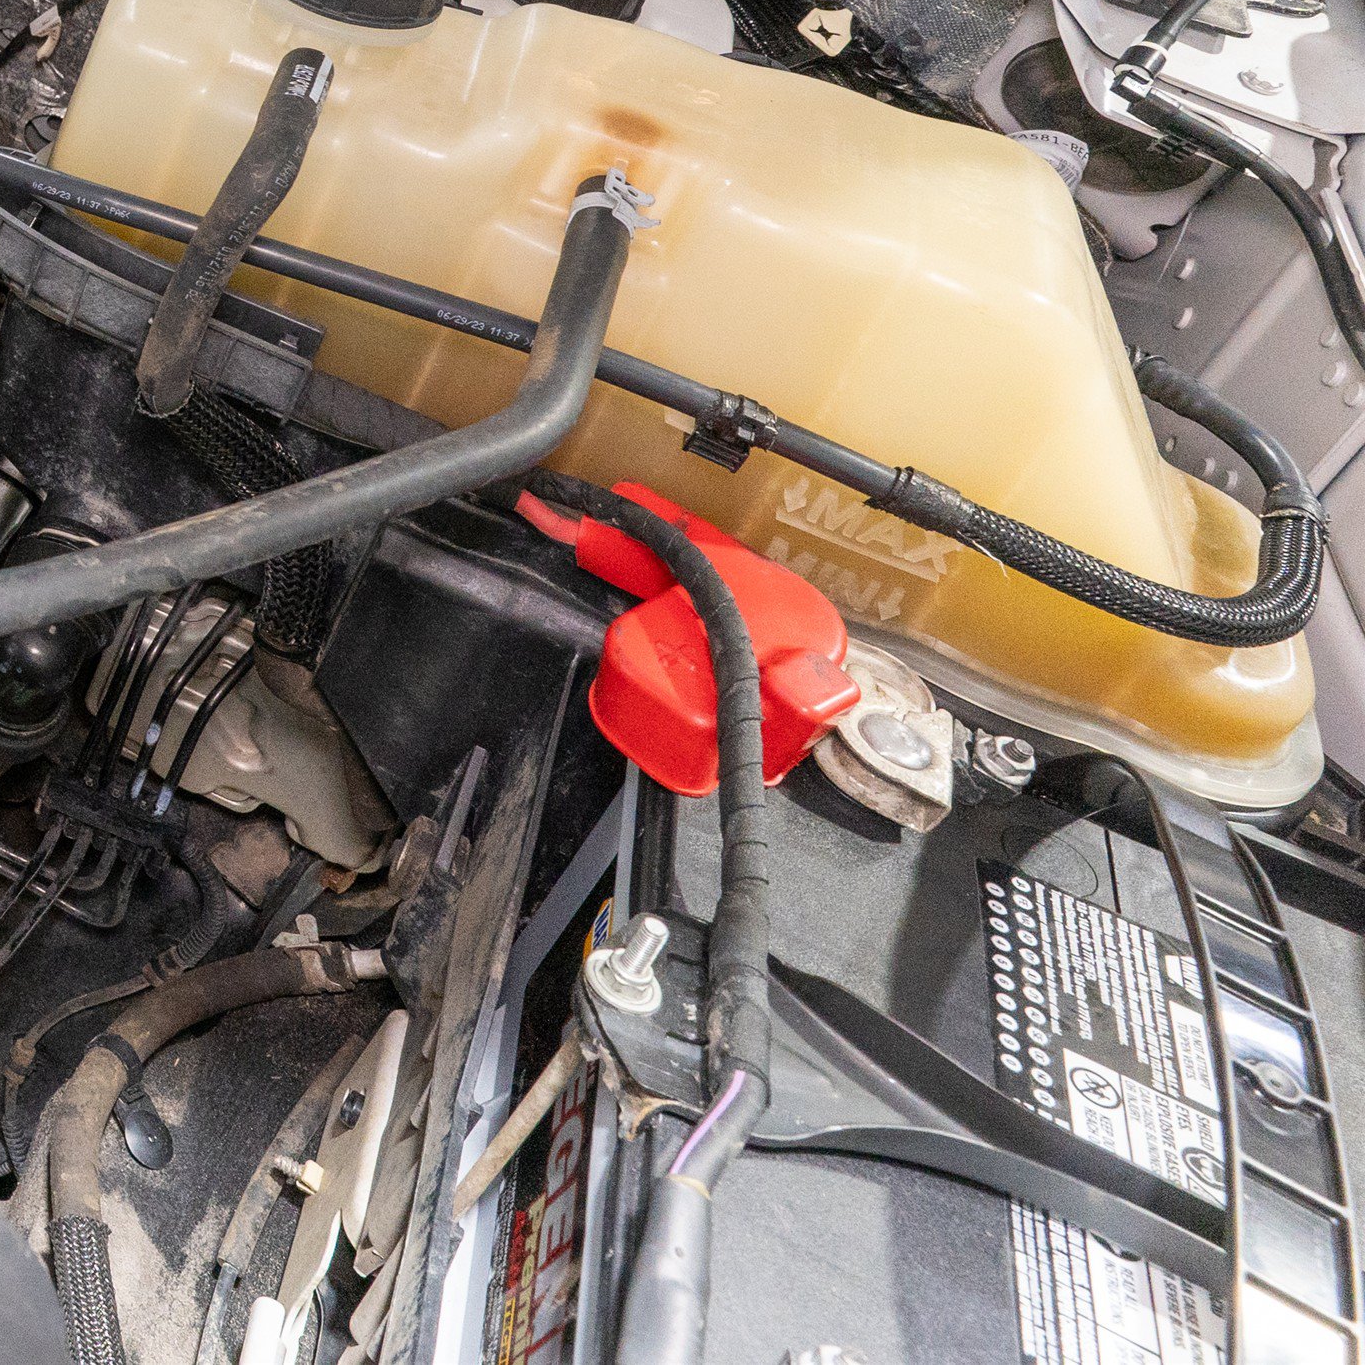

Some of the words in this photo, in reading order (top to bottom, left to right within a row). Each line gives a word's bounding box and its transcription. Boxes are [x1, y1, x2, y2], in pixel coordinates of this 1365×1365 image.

[30, 179, 72, 202] 06/29/23
[74, 194, 101, 211] 11:37
[437, 309, 485, 332] 06/29/23
[490, 326, 521, 342] 11:37
[806, 488, 963, 575] MAX
[1178, 1030, 1192, 1055] OPEN
[1191, 1036, 1204, 1055] NOT
[1194, 1052, 1211, 1092] ATTEMPT
[1153, 1093, 1177, 1151] EXPLOSIVE
[1194, 1112, 1216, 1153] SHIELD
[1144, 1130, 1163, 1176] BLINDNES
[512, 1192, 547, 1365] Premi
[1119, 1264, 1136, 1295] READ
[1162, 1278, 1181, 1318] SEVERE
